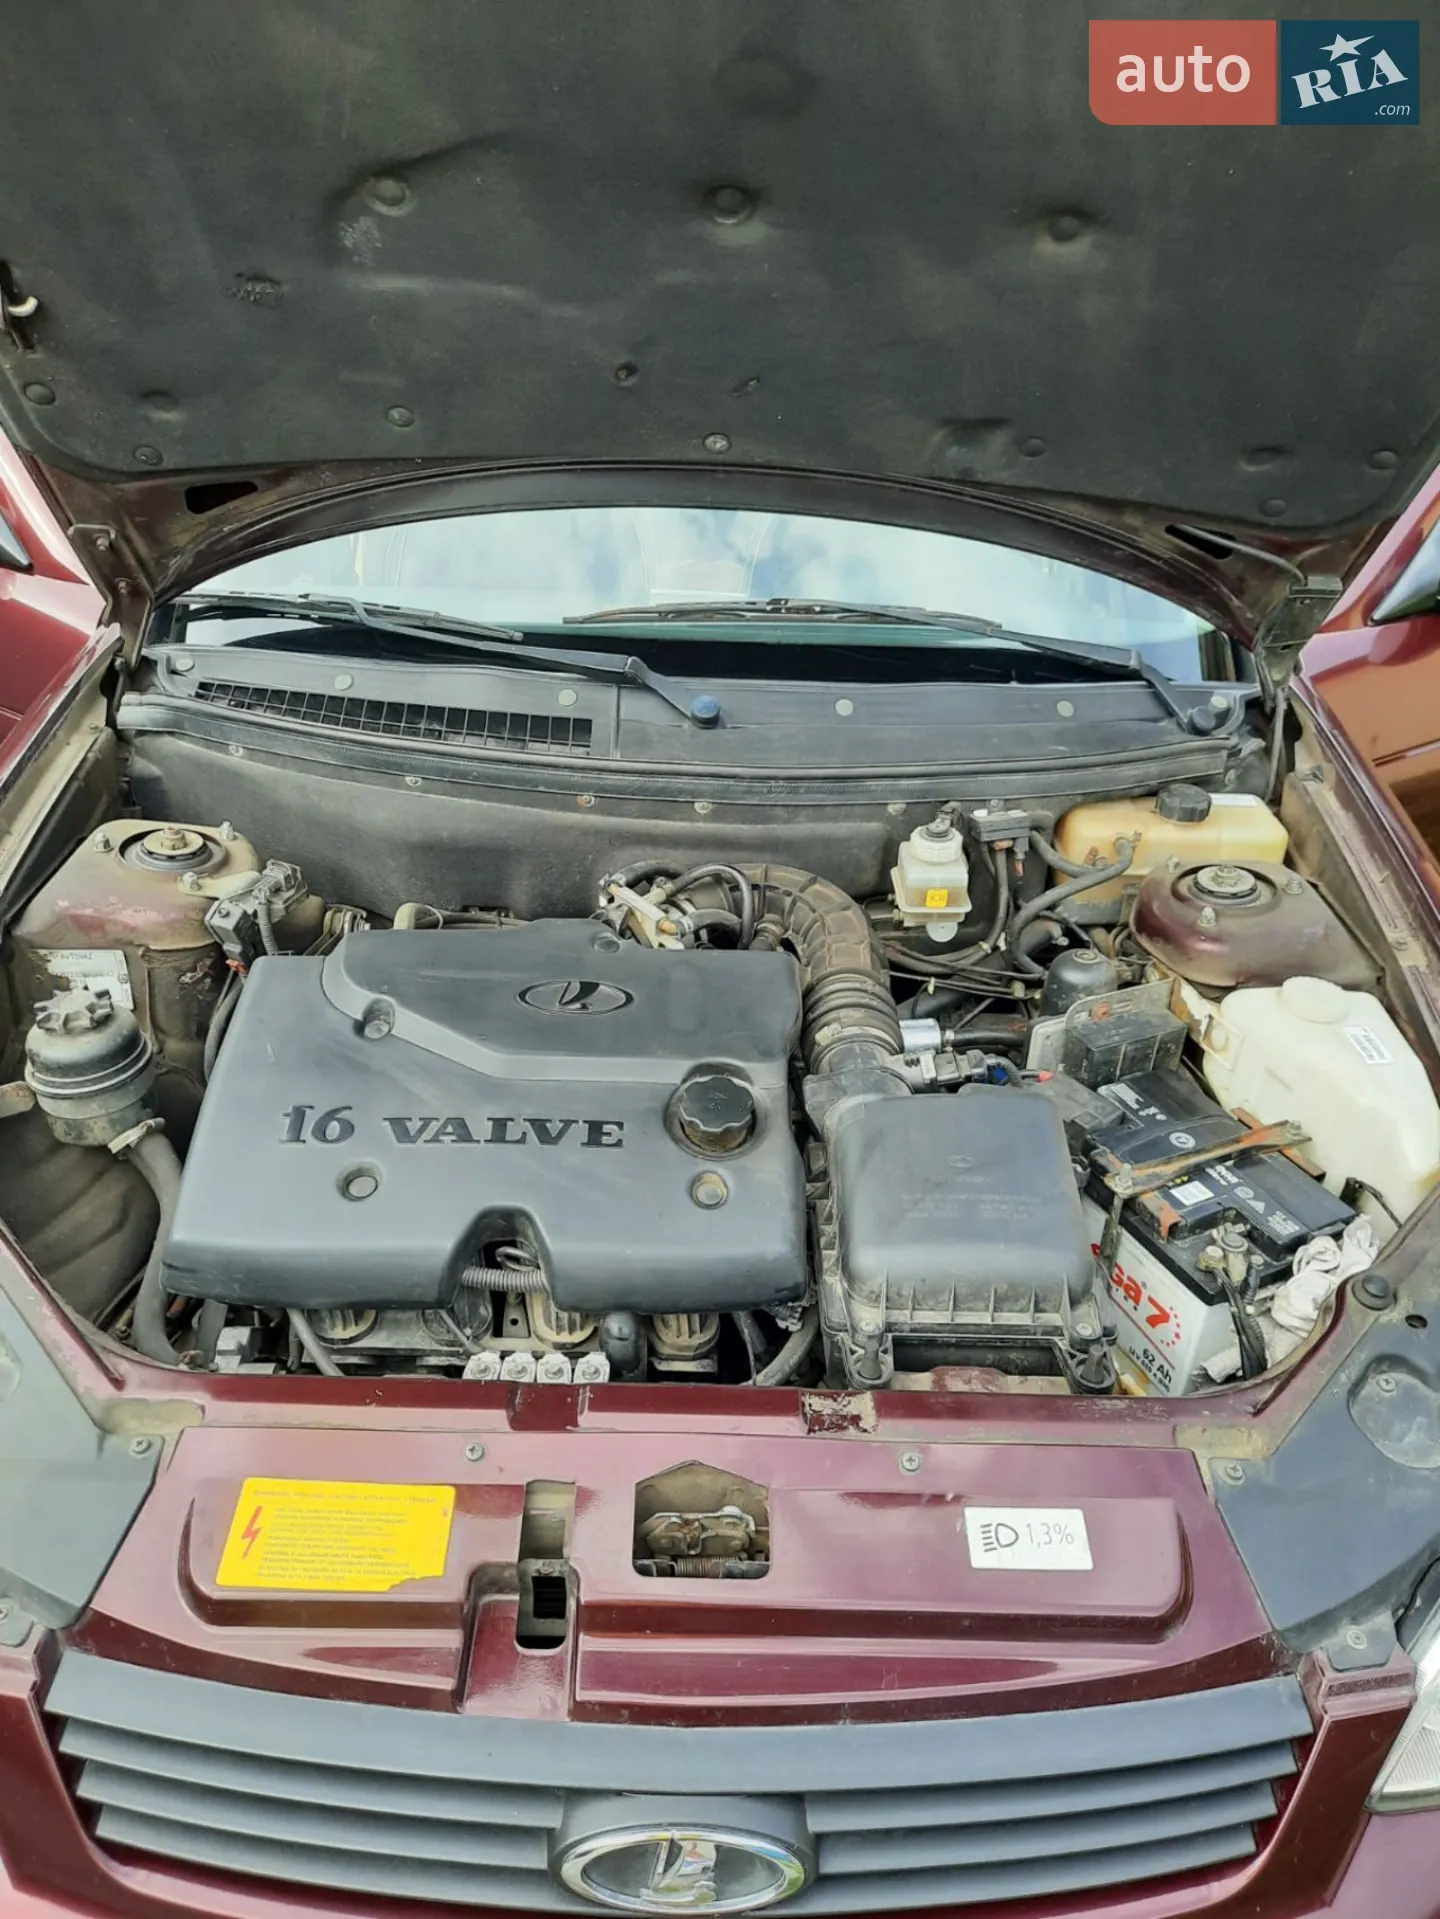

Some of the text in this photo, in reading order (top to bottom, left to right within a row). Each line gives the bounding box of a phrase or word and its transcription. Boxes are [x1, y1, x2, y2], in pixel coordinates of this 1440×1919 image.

[279, 1104, 626, 1148] 16 VALVE
[1142, 1348, 1171, 1384] 62 Ah
[1026, 1522, 1075, 1548] 1,3%
